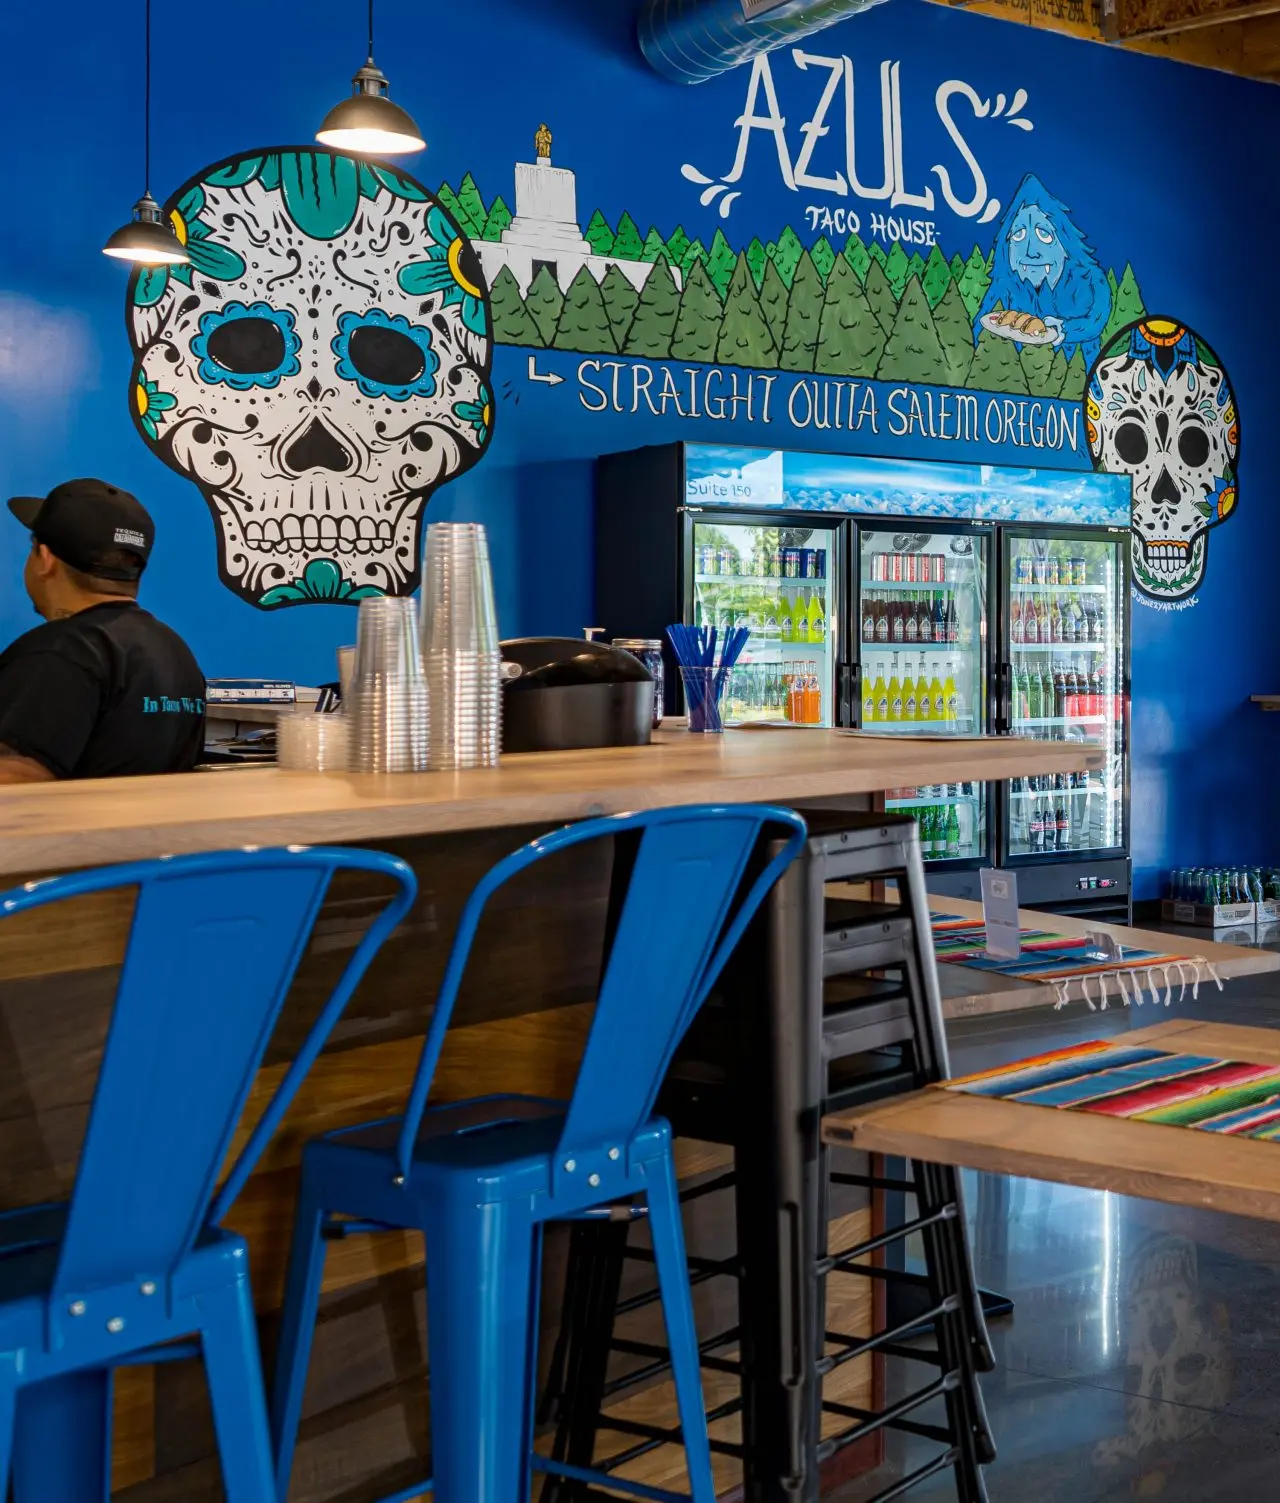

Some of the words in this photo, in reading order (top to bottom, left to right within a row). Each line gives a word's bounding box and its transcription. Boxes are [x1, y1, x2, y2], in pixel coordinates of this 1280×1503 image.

[720, 48, 991, 218] AZULS
[577, 359, 780, 423] STRAIGHT
[787, 378, 880, 434] OUTTA
[887, 386, 980, 442] SALEM
[984, 398, 1080, 452] OREGON
[687, 480, 728, 497] Suite
[731, 483, 752, 498] 150
[143, 696, 158, 713] In
[180, 697, 195, 713] We
